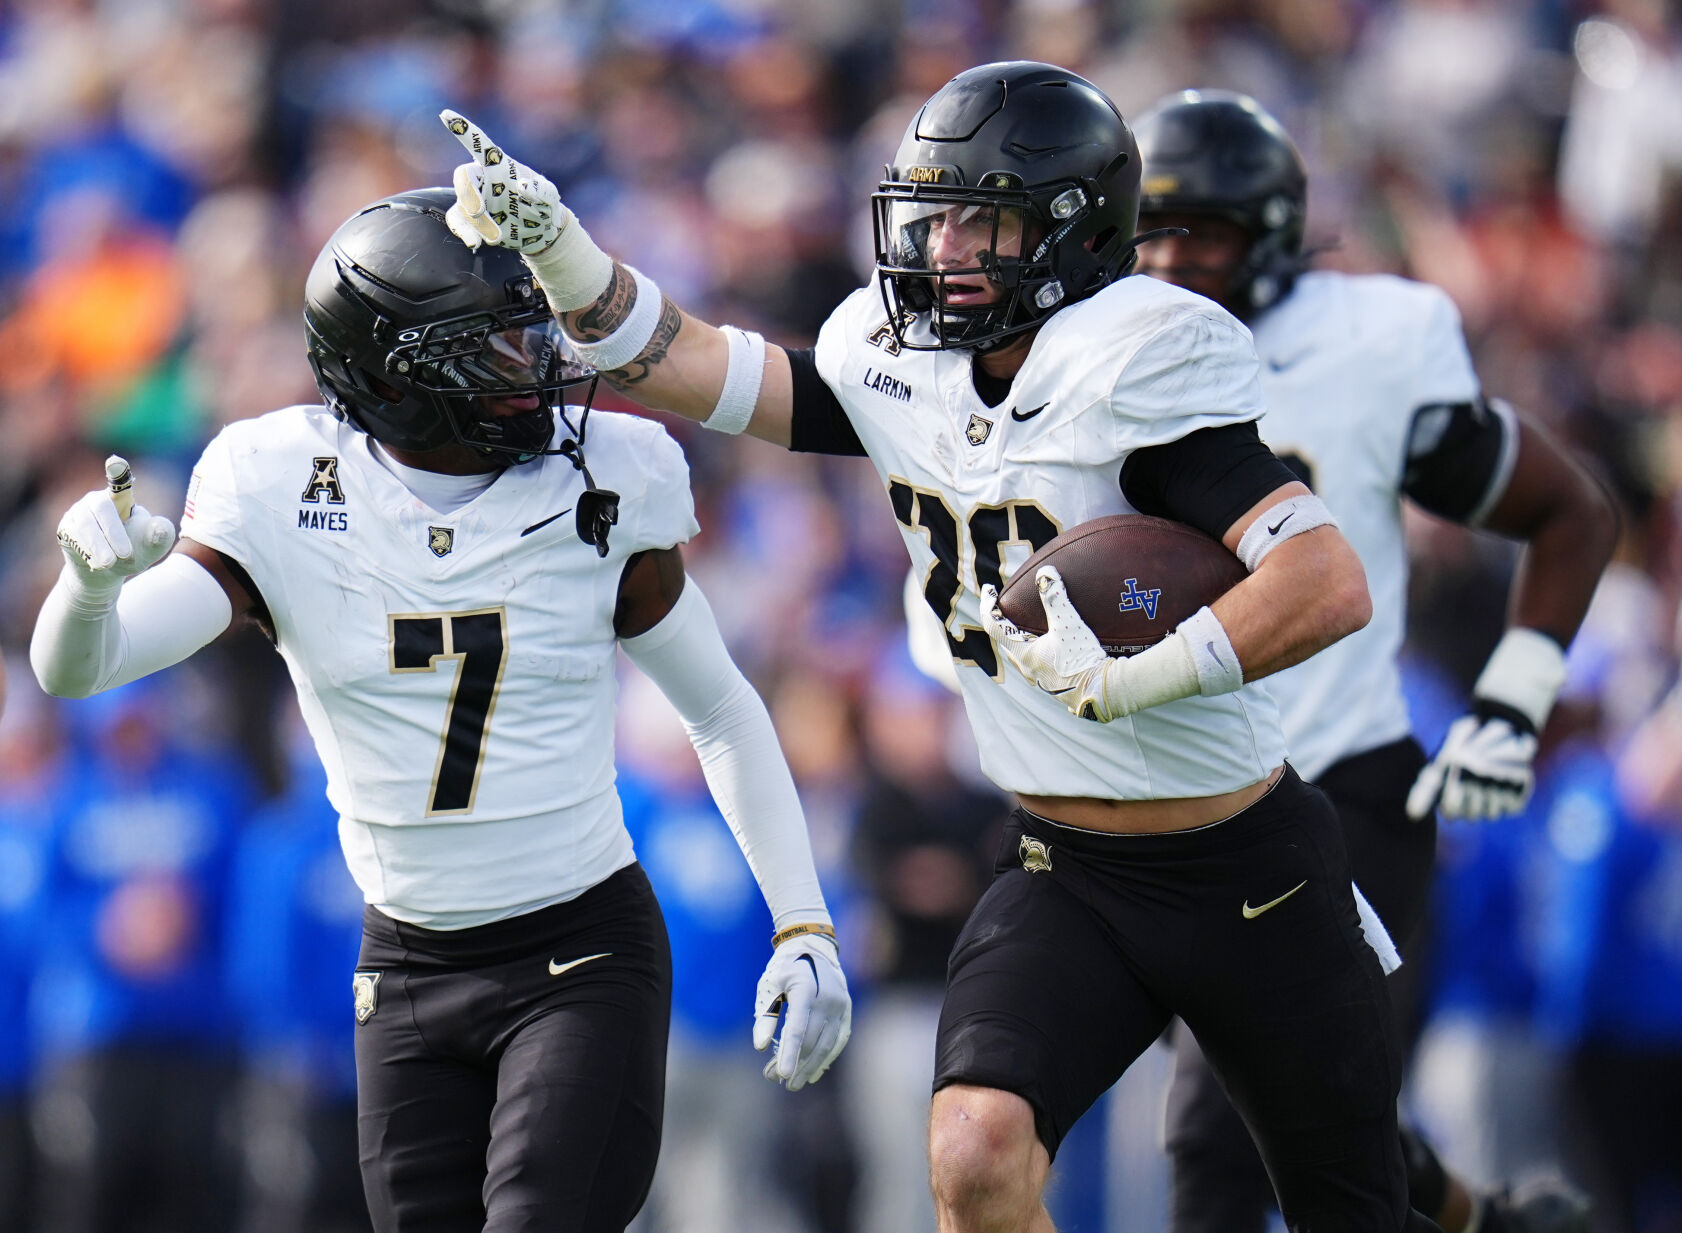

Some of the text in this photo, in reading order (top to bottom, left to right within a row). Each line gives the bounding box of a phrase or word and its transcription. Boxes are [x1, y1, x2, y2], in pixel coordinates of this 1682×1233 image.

[472, 132, 482, 154] ARMY
[908, 167, 944, 183] ARMY
[509, 190, 519, 219] ARMY
[510, 223, 519, 241] ARMY
[863, 367, 912, 403] LARKIN
[301, 456, 346, 505] A
[298, 509, 348, 531] MAYES
[1118, 577, 1162, 620] AF
[1100, 644, 1144, 653] ELITE
[387, 605, 510, 818] 7
[781, 925, 808, 939] FOOTBALL
